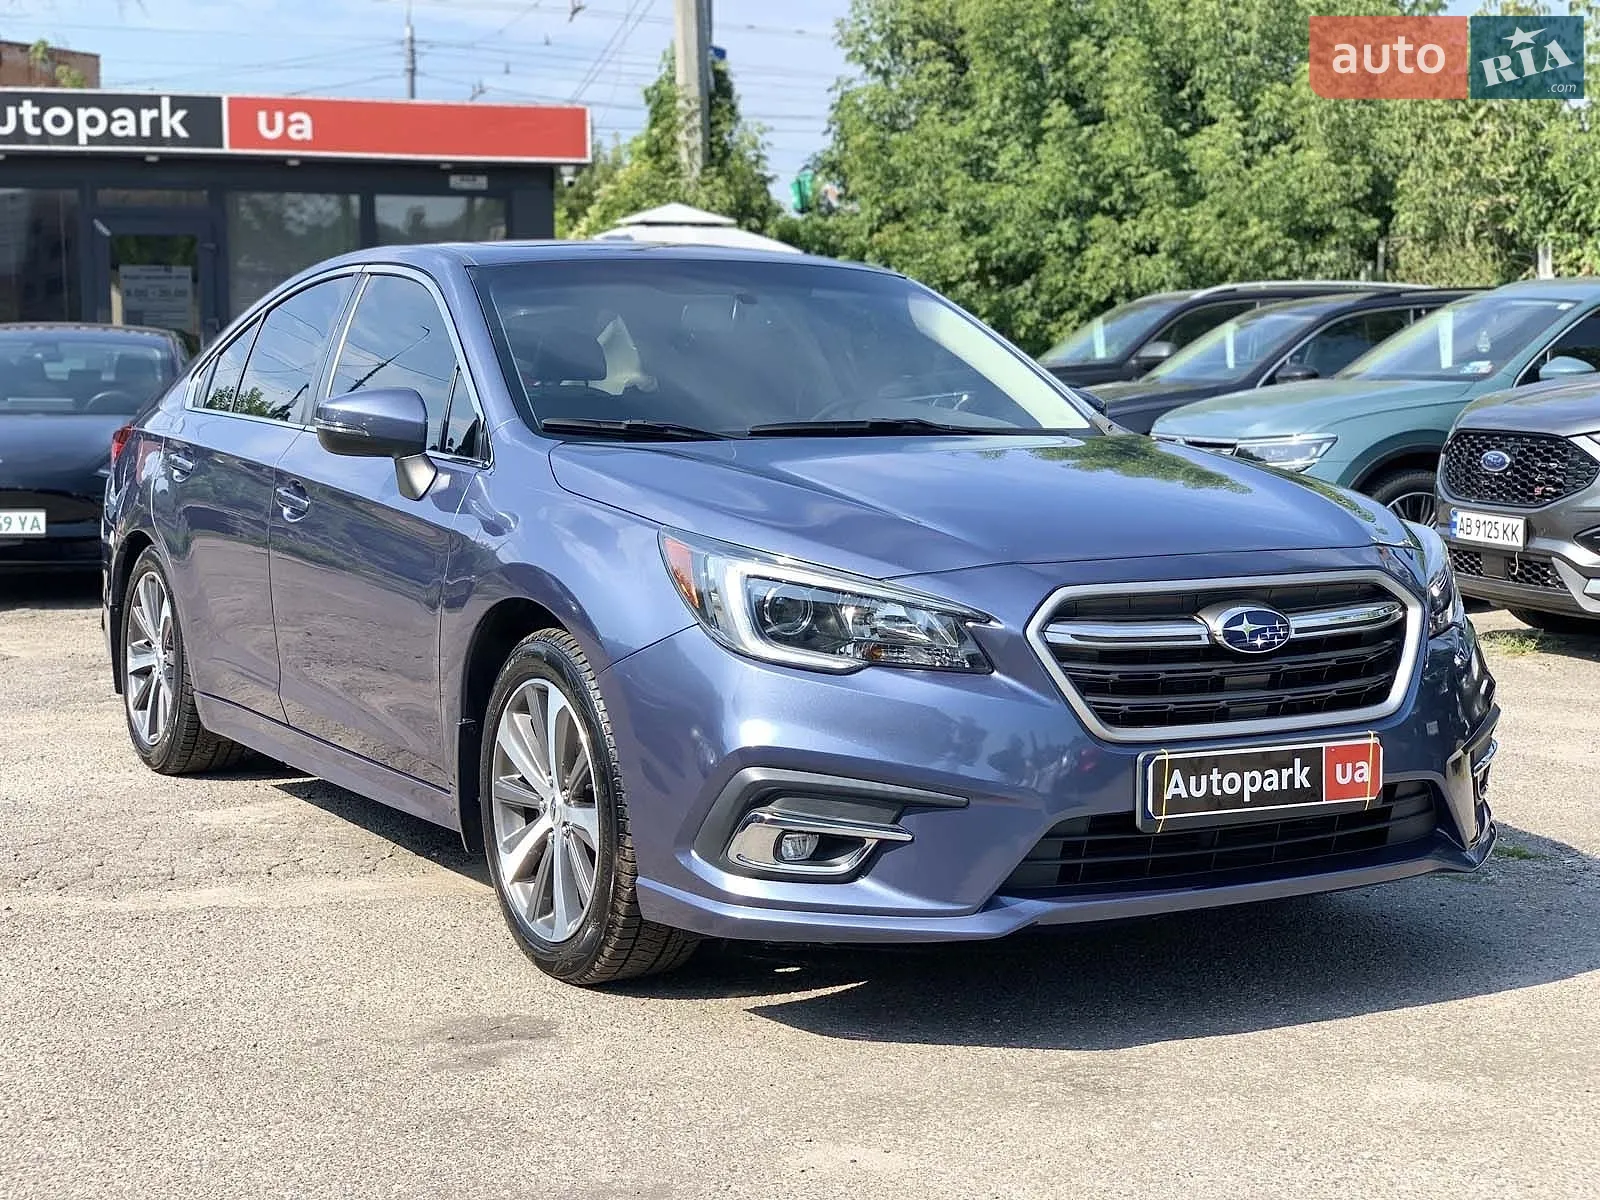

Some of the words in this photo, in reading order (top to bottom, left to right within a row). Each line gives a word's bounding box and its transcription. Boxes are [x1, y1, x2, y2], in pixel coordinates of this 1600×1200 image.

[257, 110, 313, 141] ua
[18, 515, 41, 532] YA
[1458, 517, 1473, 536] AB
[1475, 518, 1500, 540] 9125
[1502, 523, 1520, 543] KK
[1165, 758, 1312, 802] Autopark
[1335, 761, 1370, 785] ua
